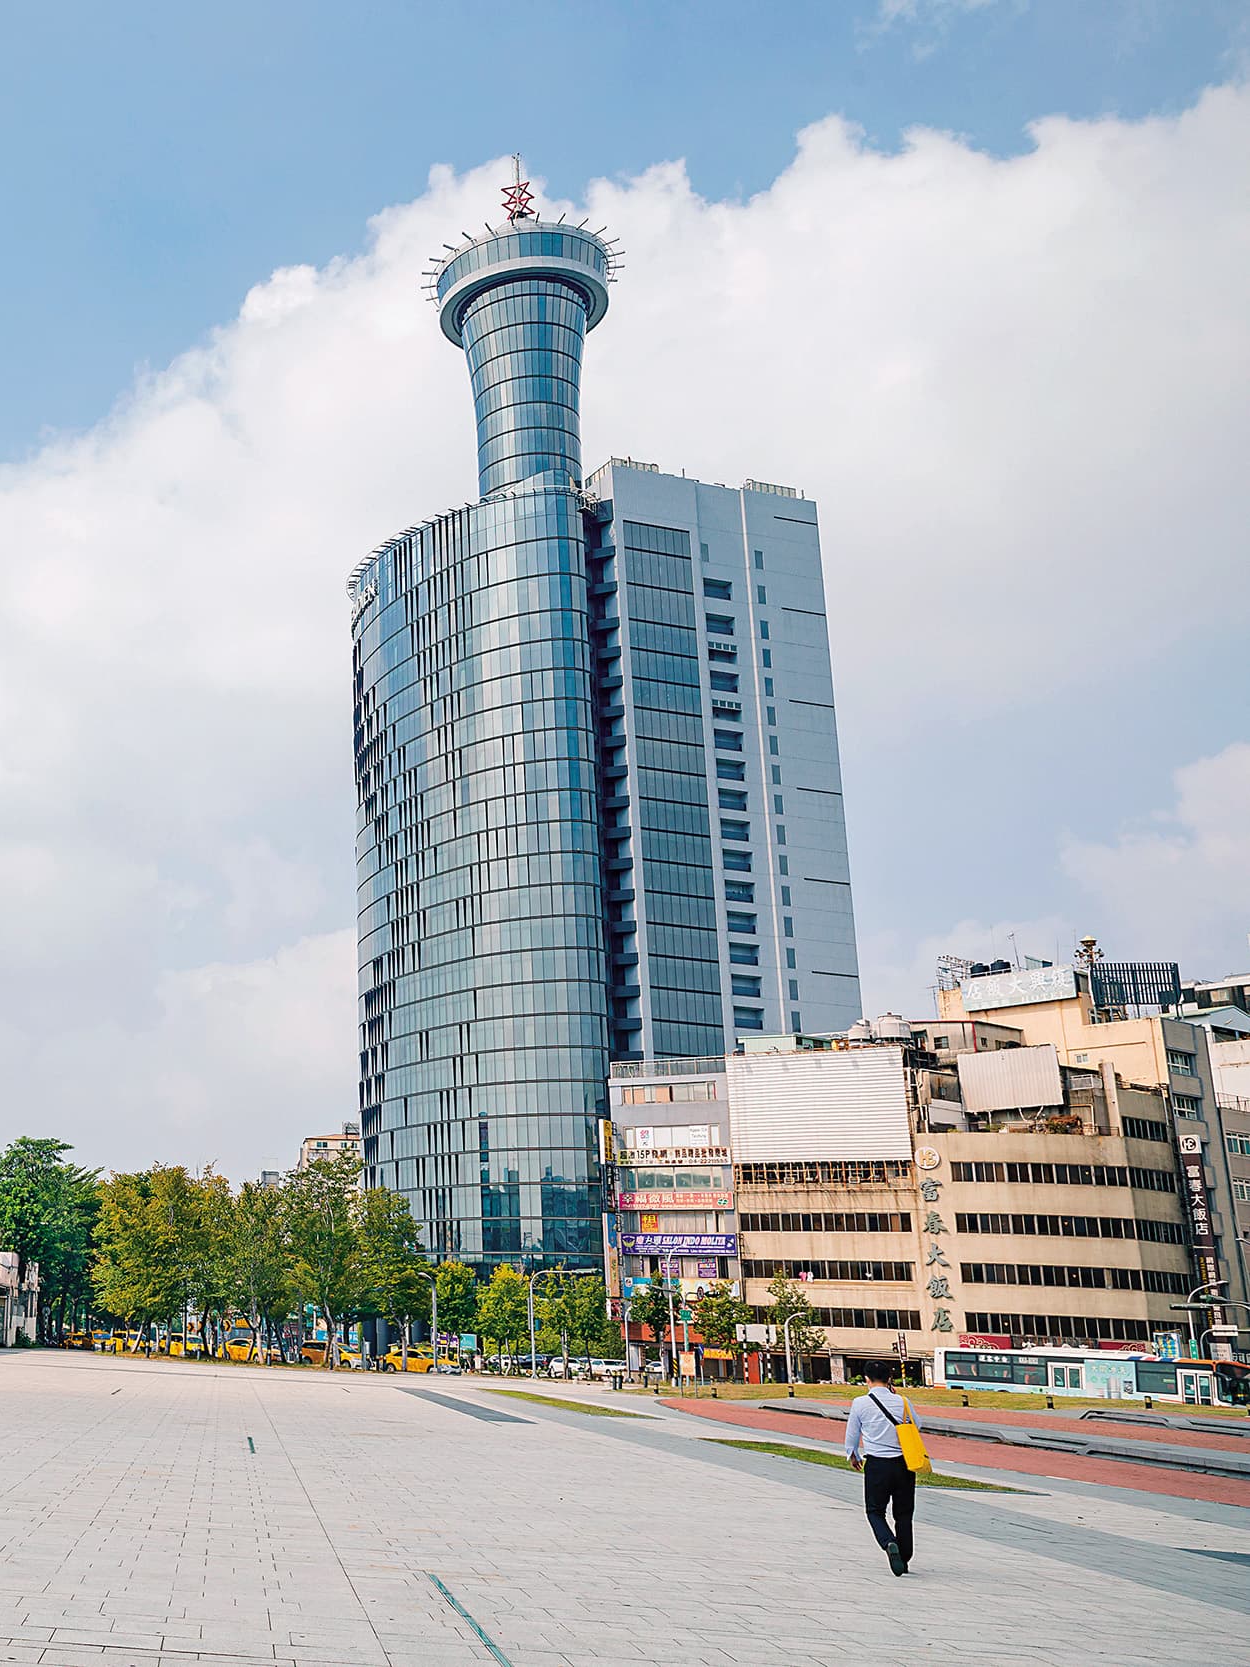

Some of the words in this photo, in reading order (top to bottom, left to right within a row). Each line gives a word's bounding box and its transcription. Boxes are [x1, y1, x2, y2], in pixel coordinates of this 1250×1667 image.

[1186, 1165, 1209, 1235] 富春大飯店
[661, 1235, 684, 1246] SALON
[683, 1236, 700, 1246] INDO
[919, 1176, 955, 1333] 富春大飯店
